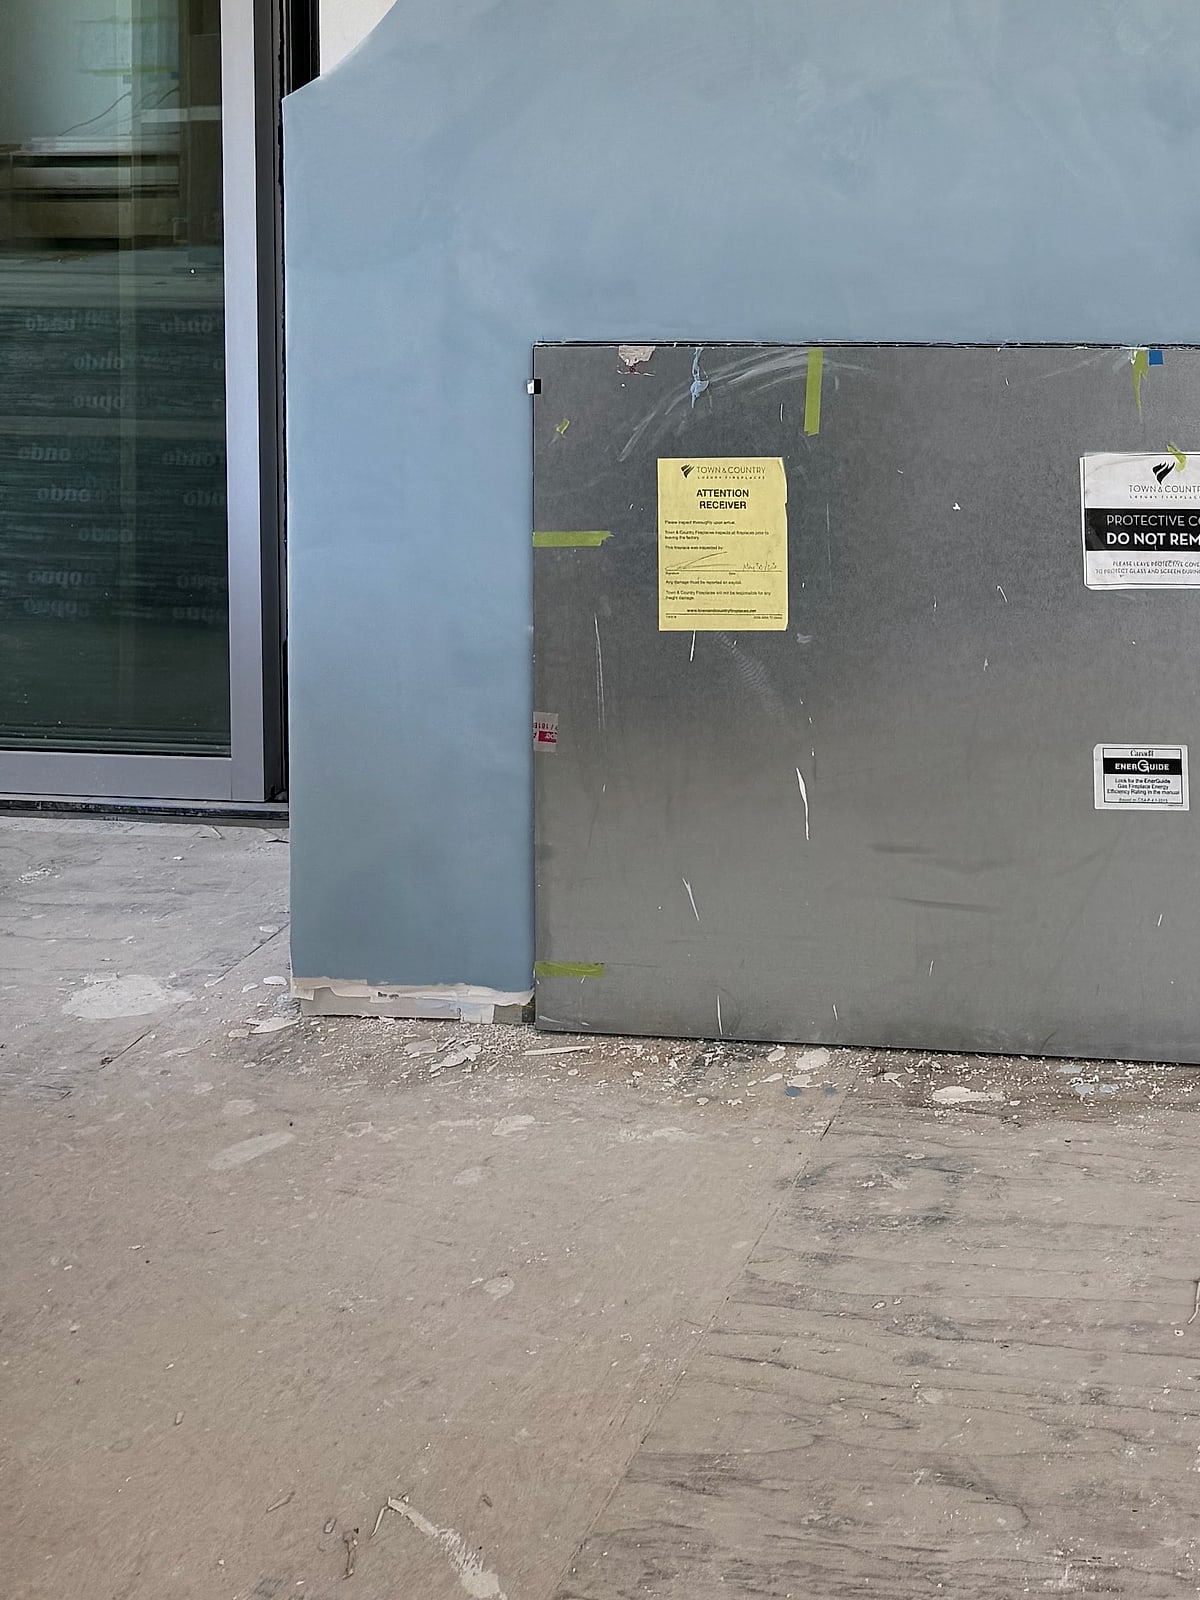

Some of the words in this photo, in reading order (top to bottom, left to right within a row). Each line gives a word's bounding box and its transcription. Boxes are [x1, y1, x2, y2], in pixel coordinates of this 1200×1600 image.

[697, 466, 721, 474] TOWN
[728, 466, 766, 474] COUNTRY
[1129, 484, 1158, 493] TOWN
[696, 489, 749, 498] ATTENTION
[699, 500, 747, 510] RECEIVER
[1106, 514, 1185, 527] PROTECTIVE
[1106, 532, 1130, 545] DO
[1134, 532, 1166, 546] NOT
